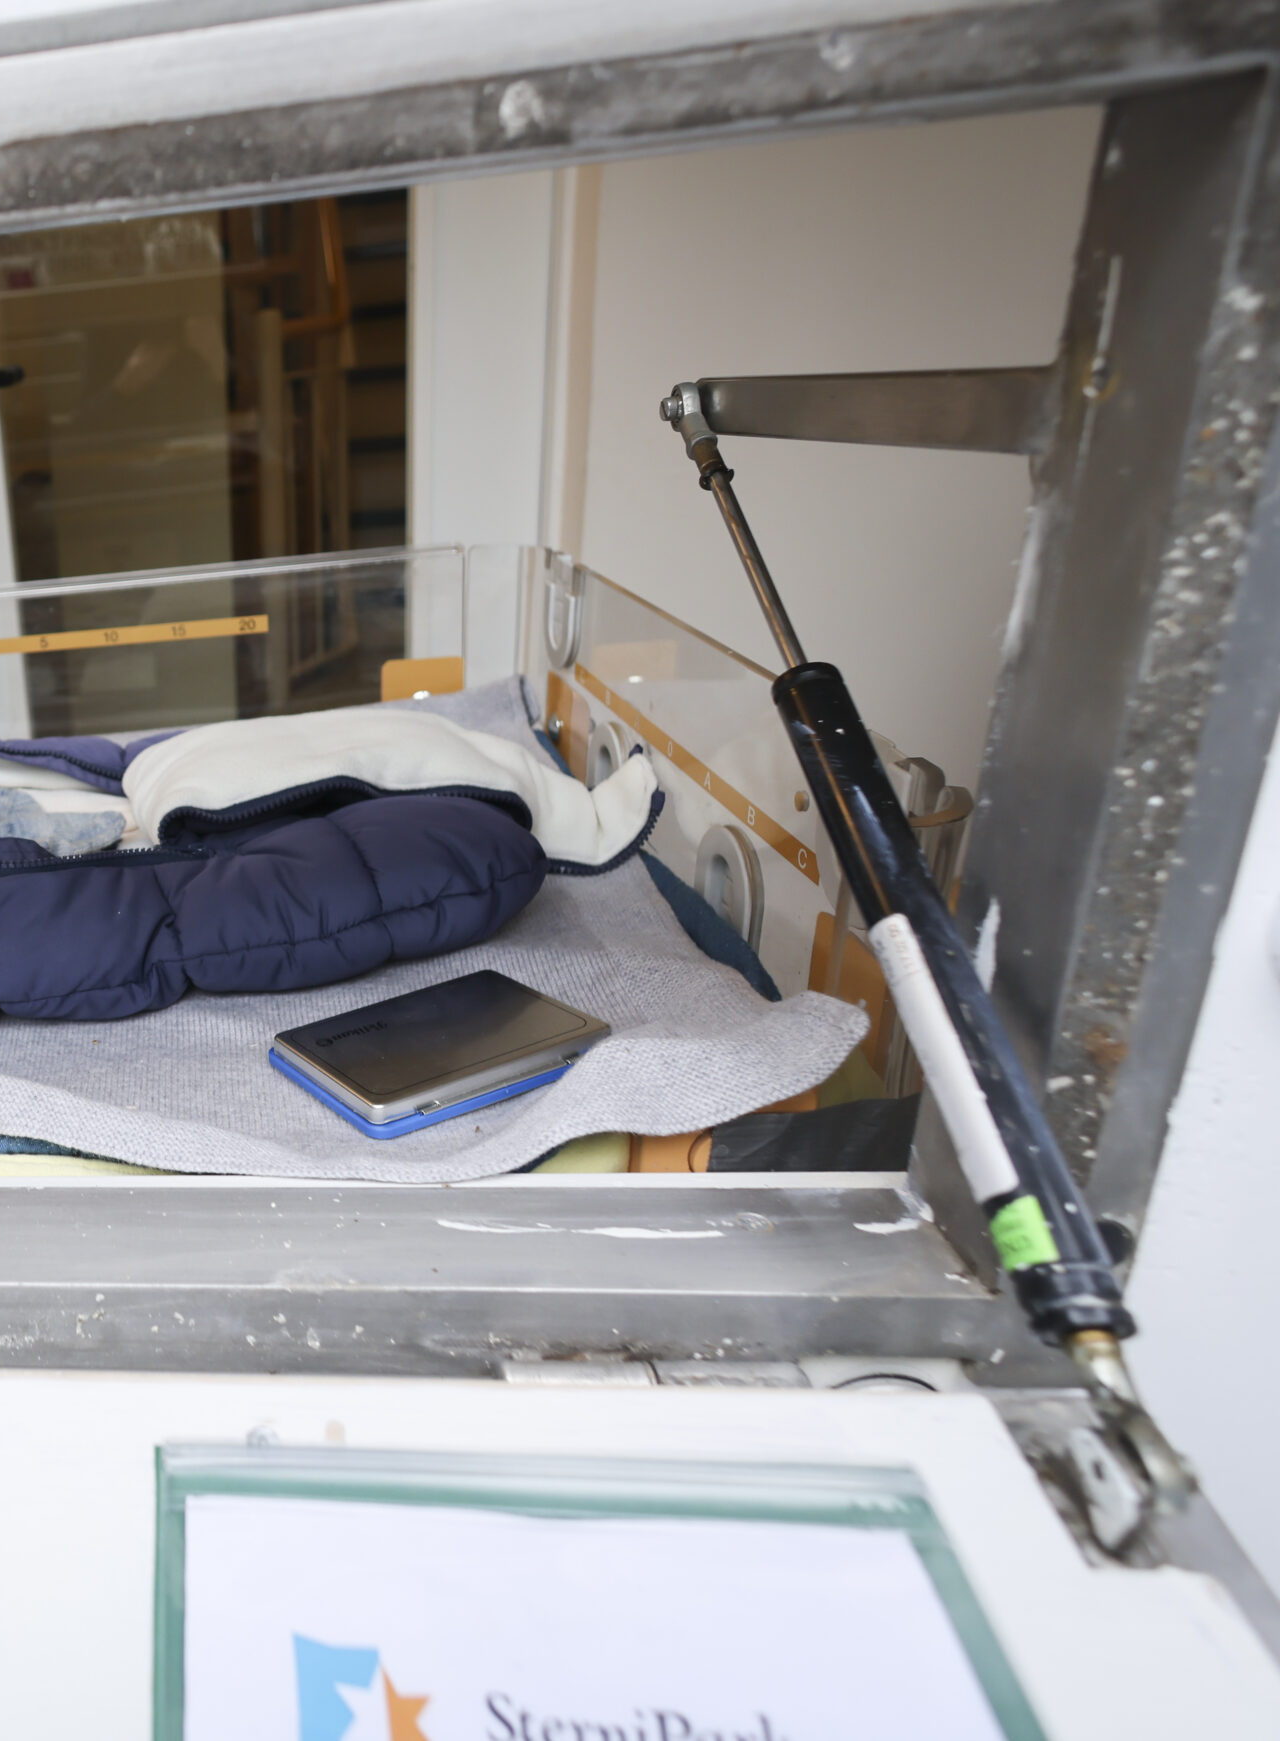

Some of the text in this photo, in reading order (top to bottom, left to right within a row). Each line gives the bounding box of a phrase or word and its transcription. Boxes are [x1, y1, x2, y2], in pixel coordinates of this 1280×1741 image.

[39, 636, 49, 649] 5
[104, 630, 119, 643] 10
[171, 624, 187, 637] 15
[238, 618, 257, 632] 20
[703, 771, 711, 791] A
[747, 806, 756, 827] B
[797, 849, 808, 870] C
[484, 1690, 791, 1741] SterniPk
